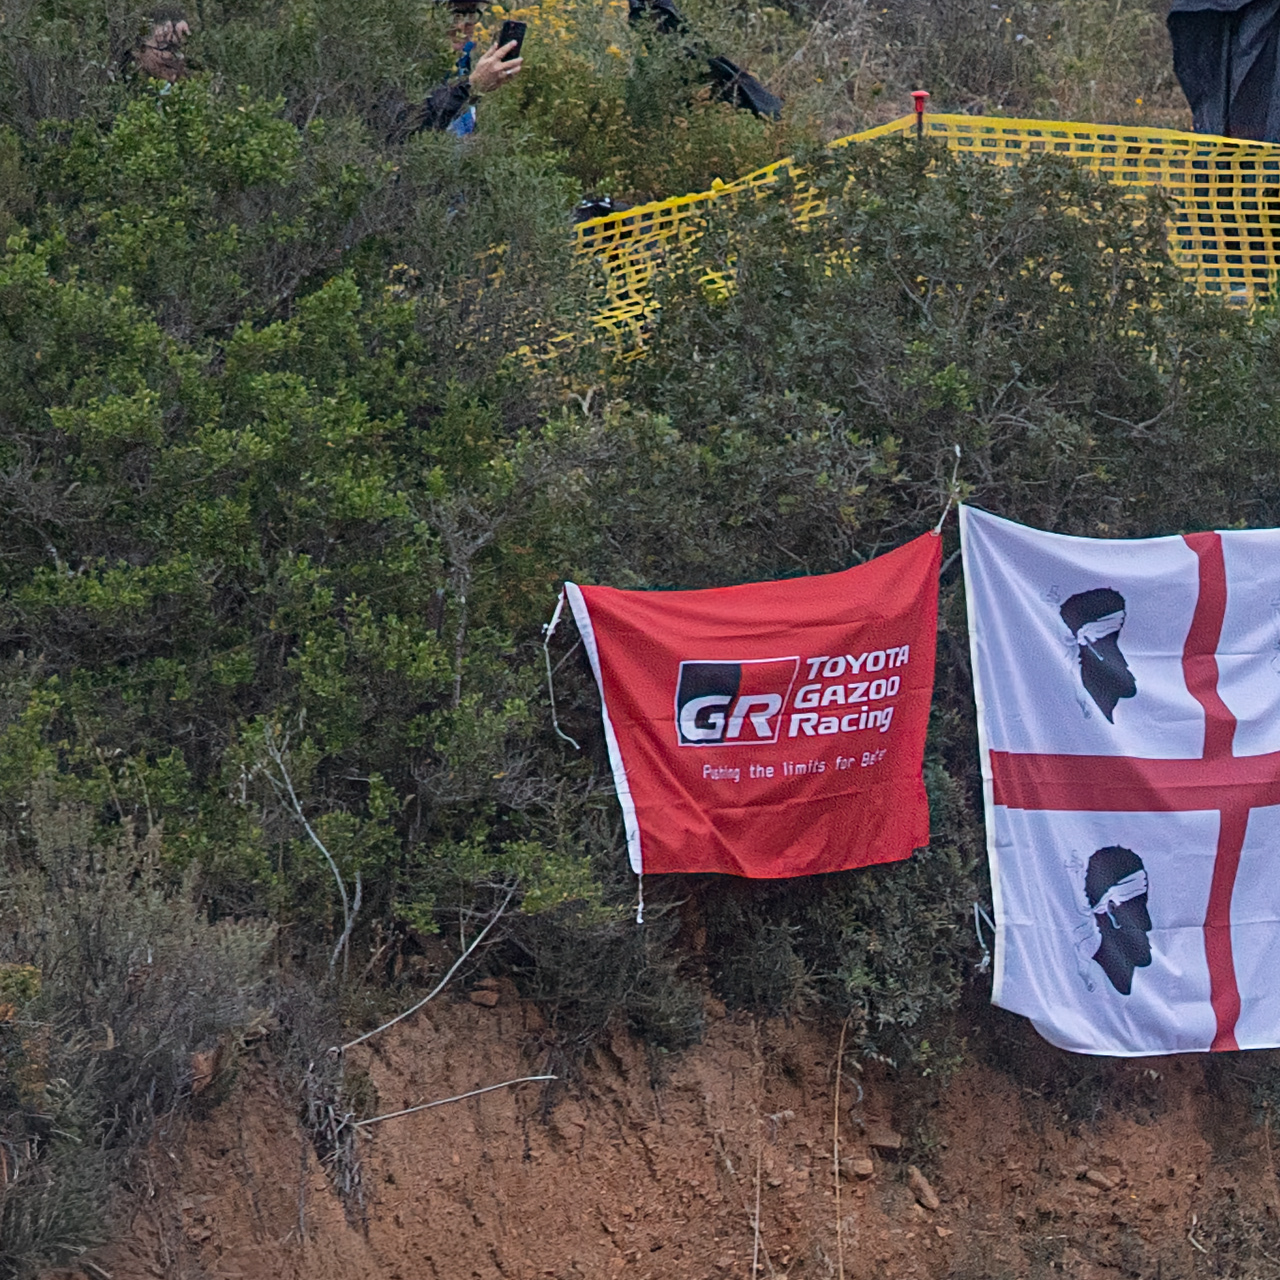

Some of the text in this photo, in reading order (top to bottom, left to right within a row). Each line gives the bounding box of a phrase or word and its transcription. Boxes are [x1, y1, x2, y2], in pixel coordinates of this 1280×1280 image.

[806, 645, 910, 681] TOYOTA
[794, 675, 901, 710] GAZOO
[679, 693, 783, 741] GR
[788, 706, 895, 738] Racing
[749, 764, 775, 779] the
[783, 759, 827, 776] limits
[836, 755, 856, 770] for
